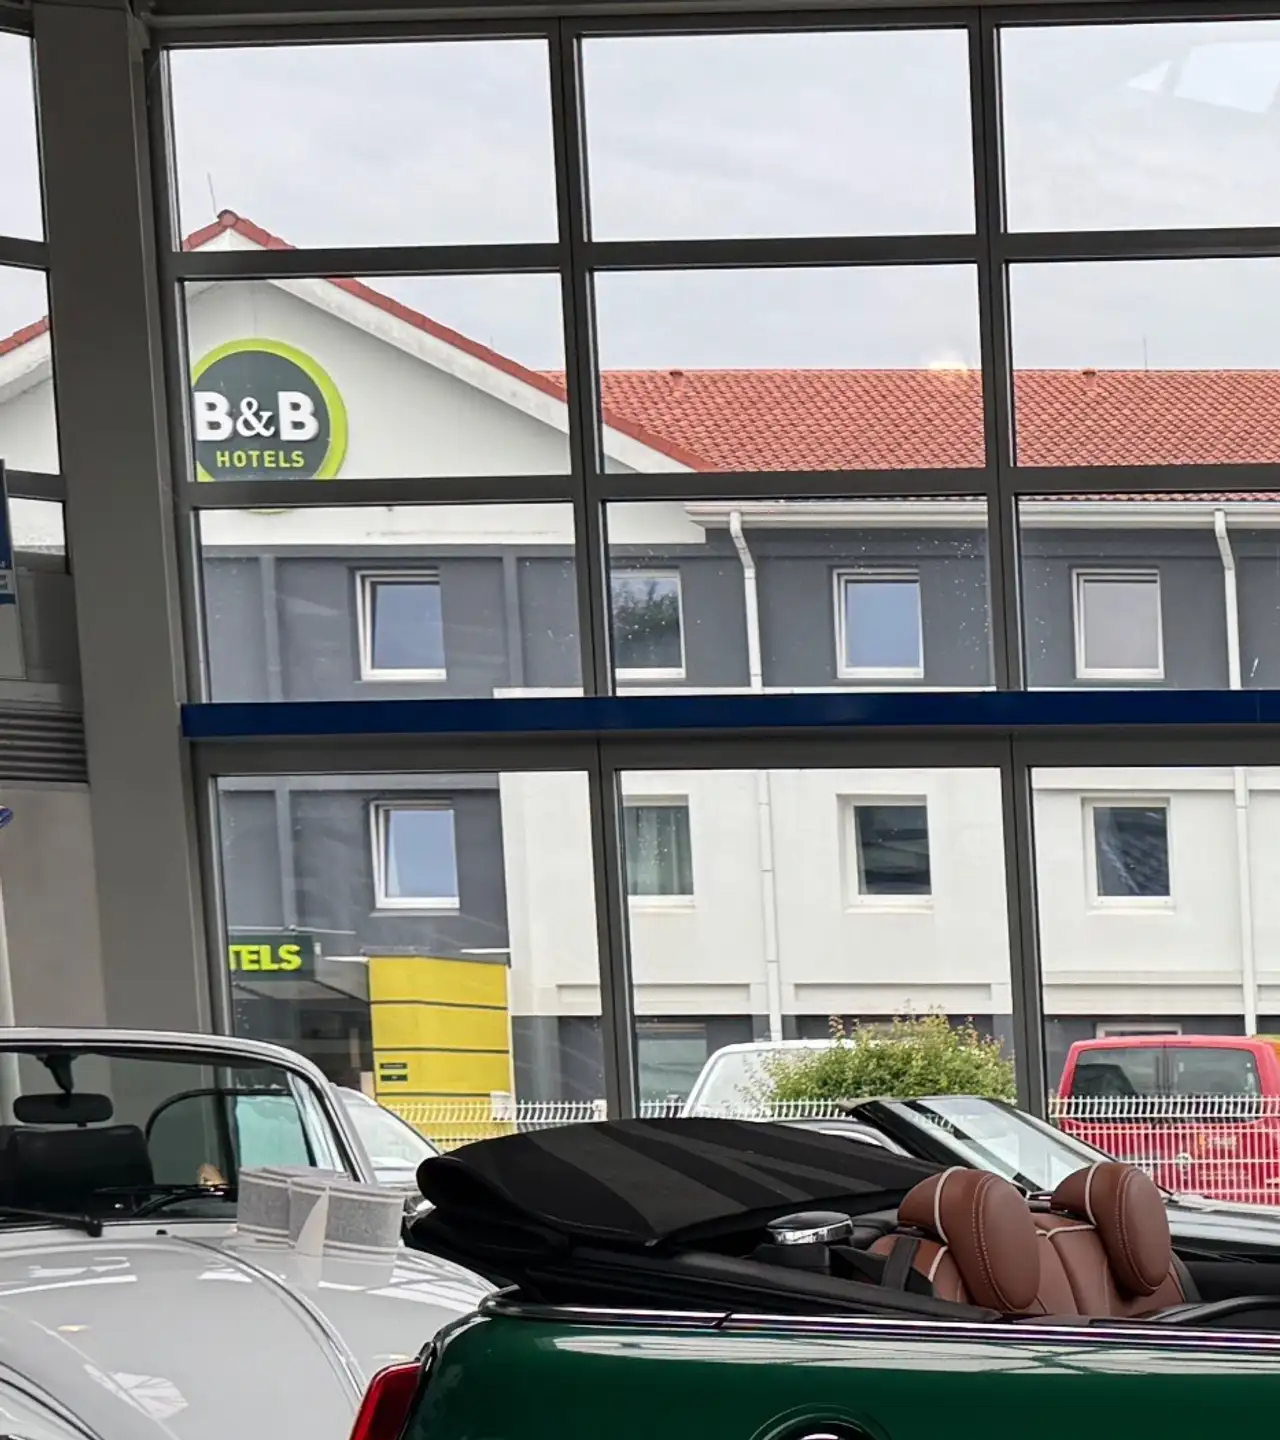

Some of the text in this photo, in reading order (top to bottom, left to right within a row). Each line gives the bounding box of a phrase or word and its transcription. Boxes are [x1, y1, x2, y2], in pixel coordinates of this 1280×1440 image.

[193, 391, 319, 441] B&B
[216, 450, 305, 468] HOTELS
[228, 944, 302, 972] TELS
